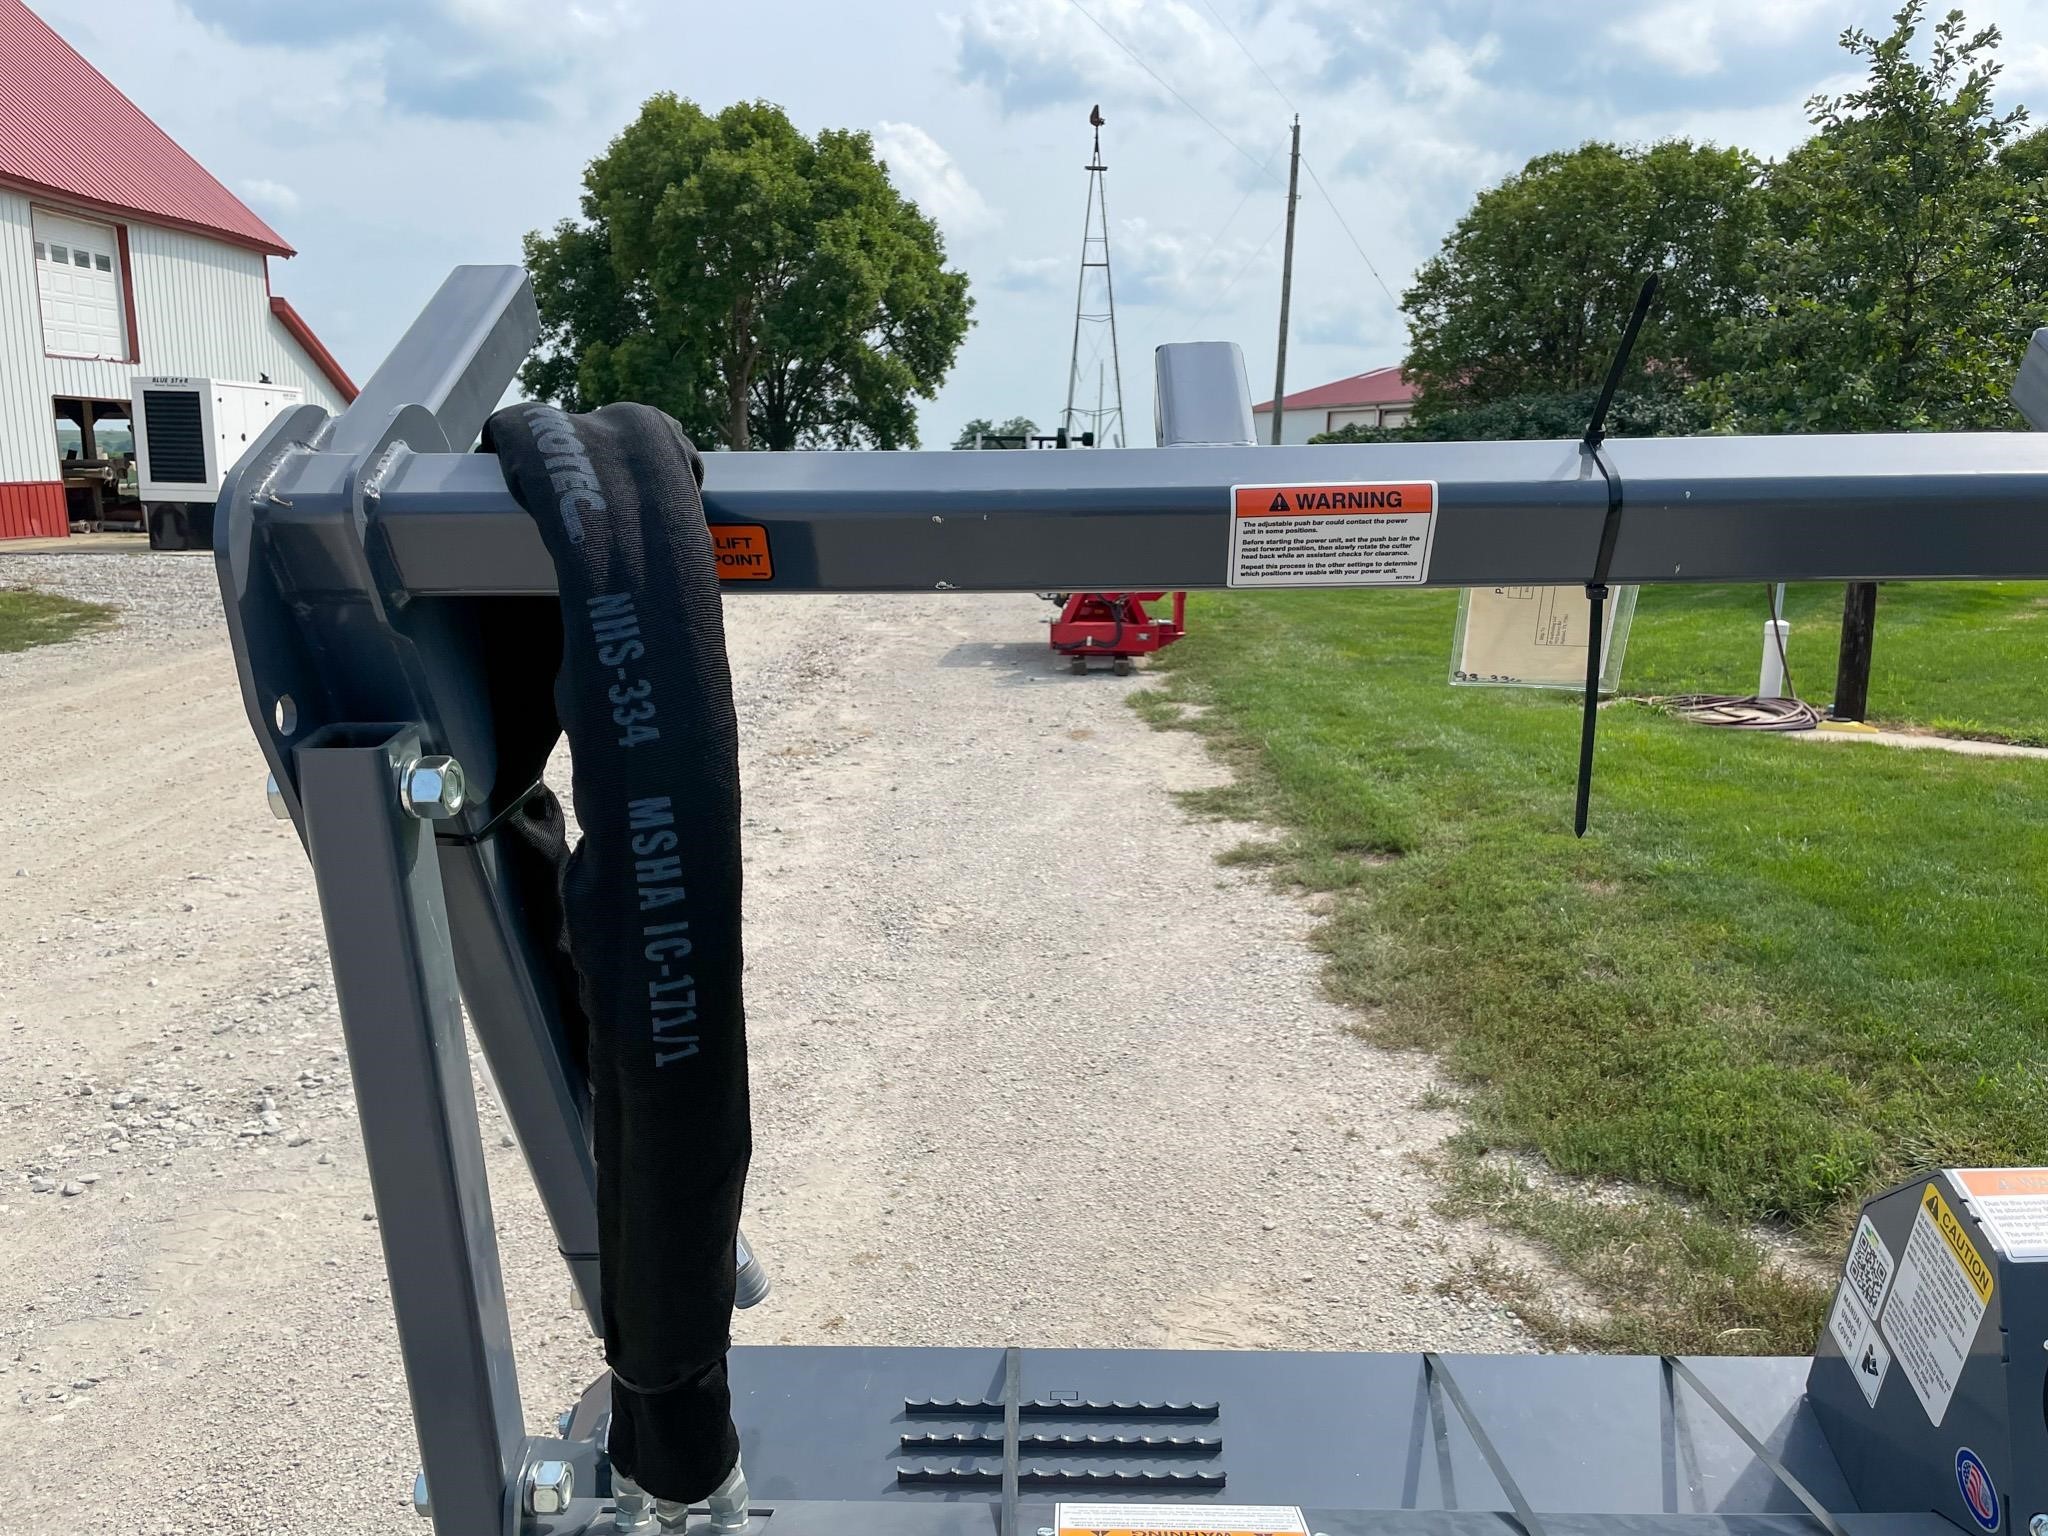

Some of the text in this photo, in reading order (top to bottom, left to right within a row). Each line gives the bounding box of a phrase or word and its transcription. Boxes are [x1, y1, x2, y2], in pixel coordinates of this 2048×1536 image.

[1295, 490, 1403, 511] WARNING
[715, 537, 753, 549] LIFT
[586, 592, 660, 748] NHS-334
[628, 796, 685, 911] MSHA
[643, 921, 699, 1067] IC-171/1
[1942, 1211, 1990, 1290] CAUTION
[1841, 1308, 1857, 1340] UNDER
[1842, 1293, 1862, 1331] MANUAL
[1837, 1321, 1853, 1349] COVER
